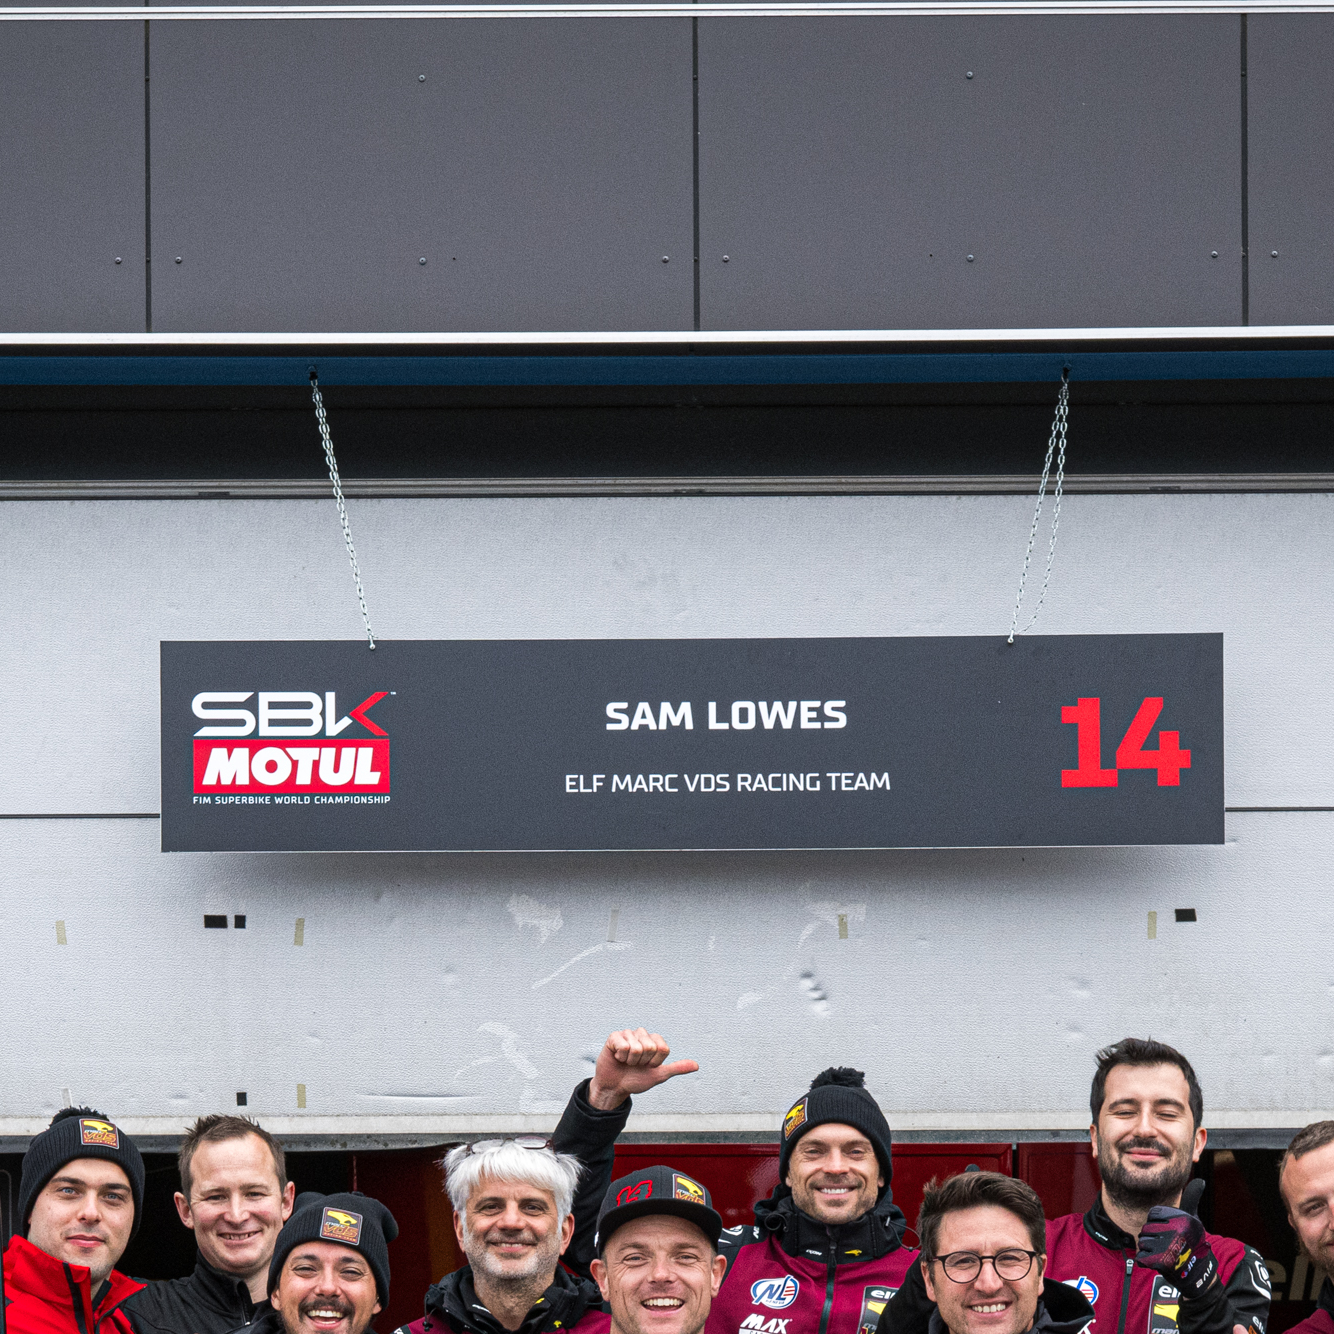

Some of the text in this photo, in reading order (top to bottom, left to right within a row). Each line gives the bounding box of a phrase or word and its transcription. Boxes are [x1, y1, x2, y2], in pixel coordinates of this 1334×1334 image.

[192, 691, 389, 737] SBK
[605, 700, 847, 731] SAM LOWES
[1060, 696, 1192, 788] 14
[202, 746, 381, 786] MOTUL
[565, 772, 891, 793] ELF MARC VDS RACING TEAM
[193, 795, 391, 805] FIM SUPERBIKE WORLD CHAMPIONSHIP
[740, 1313, 789, 1334] MAX
